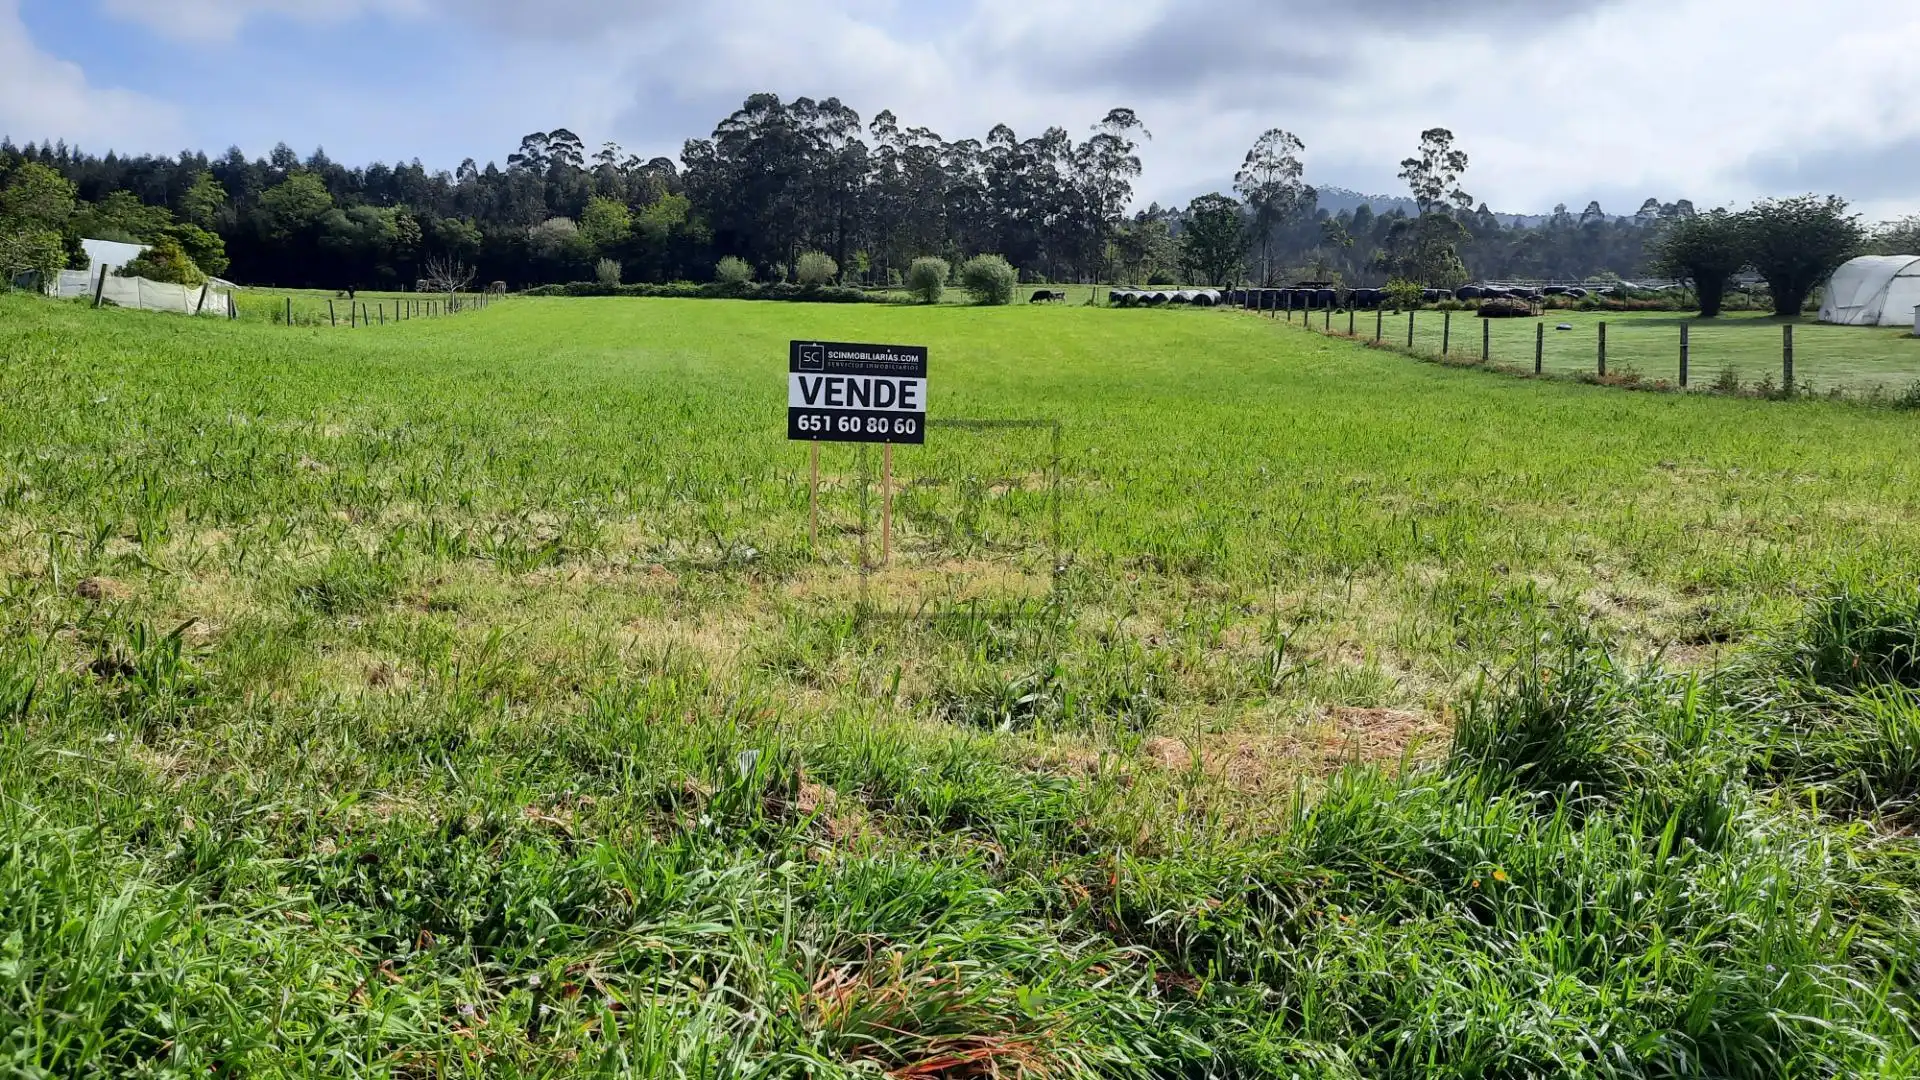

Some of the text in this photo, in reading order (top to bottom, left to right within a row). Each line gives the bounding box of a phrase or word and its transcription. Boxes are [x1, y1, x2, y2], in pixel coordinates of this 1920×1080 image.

[803, 351, 820, 363] SC
[828, 351, 919, 363] SCINMOBILIARIAS.COM
[798, 376, 918, 409] VENDE
[798, 415, 916, 434] 651 60 80 60
